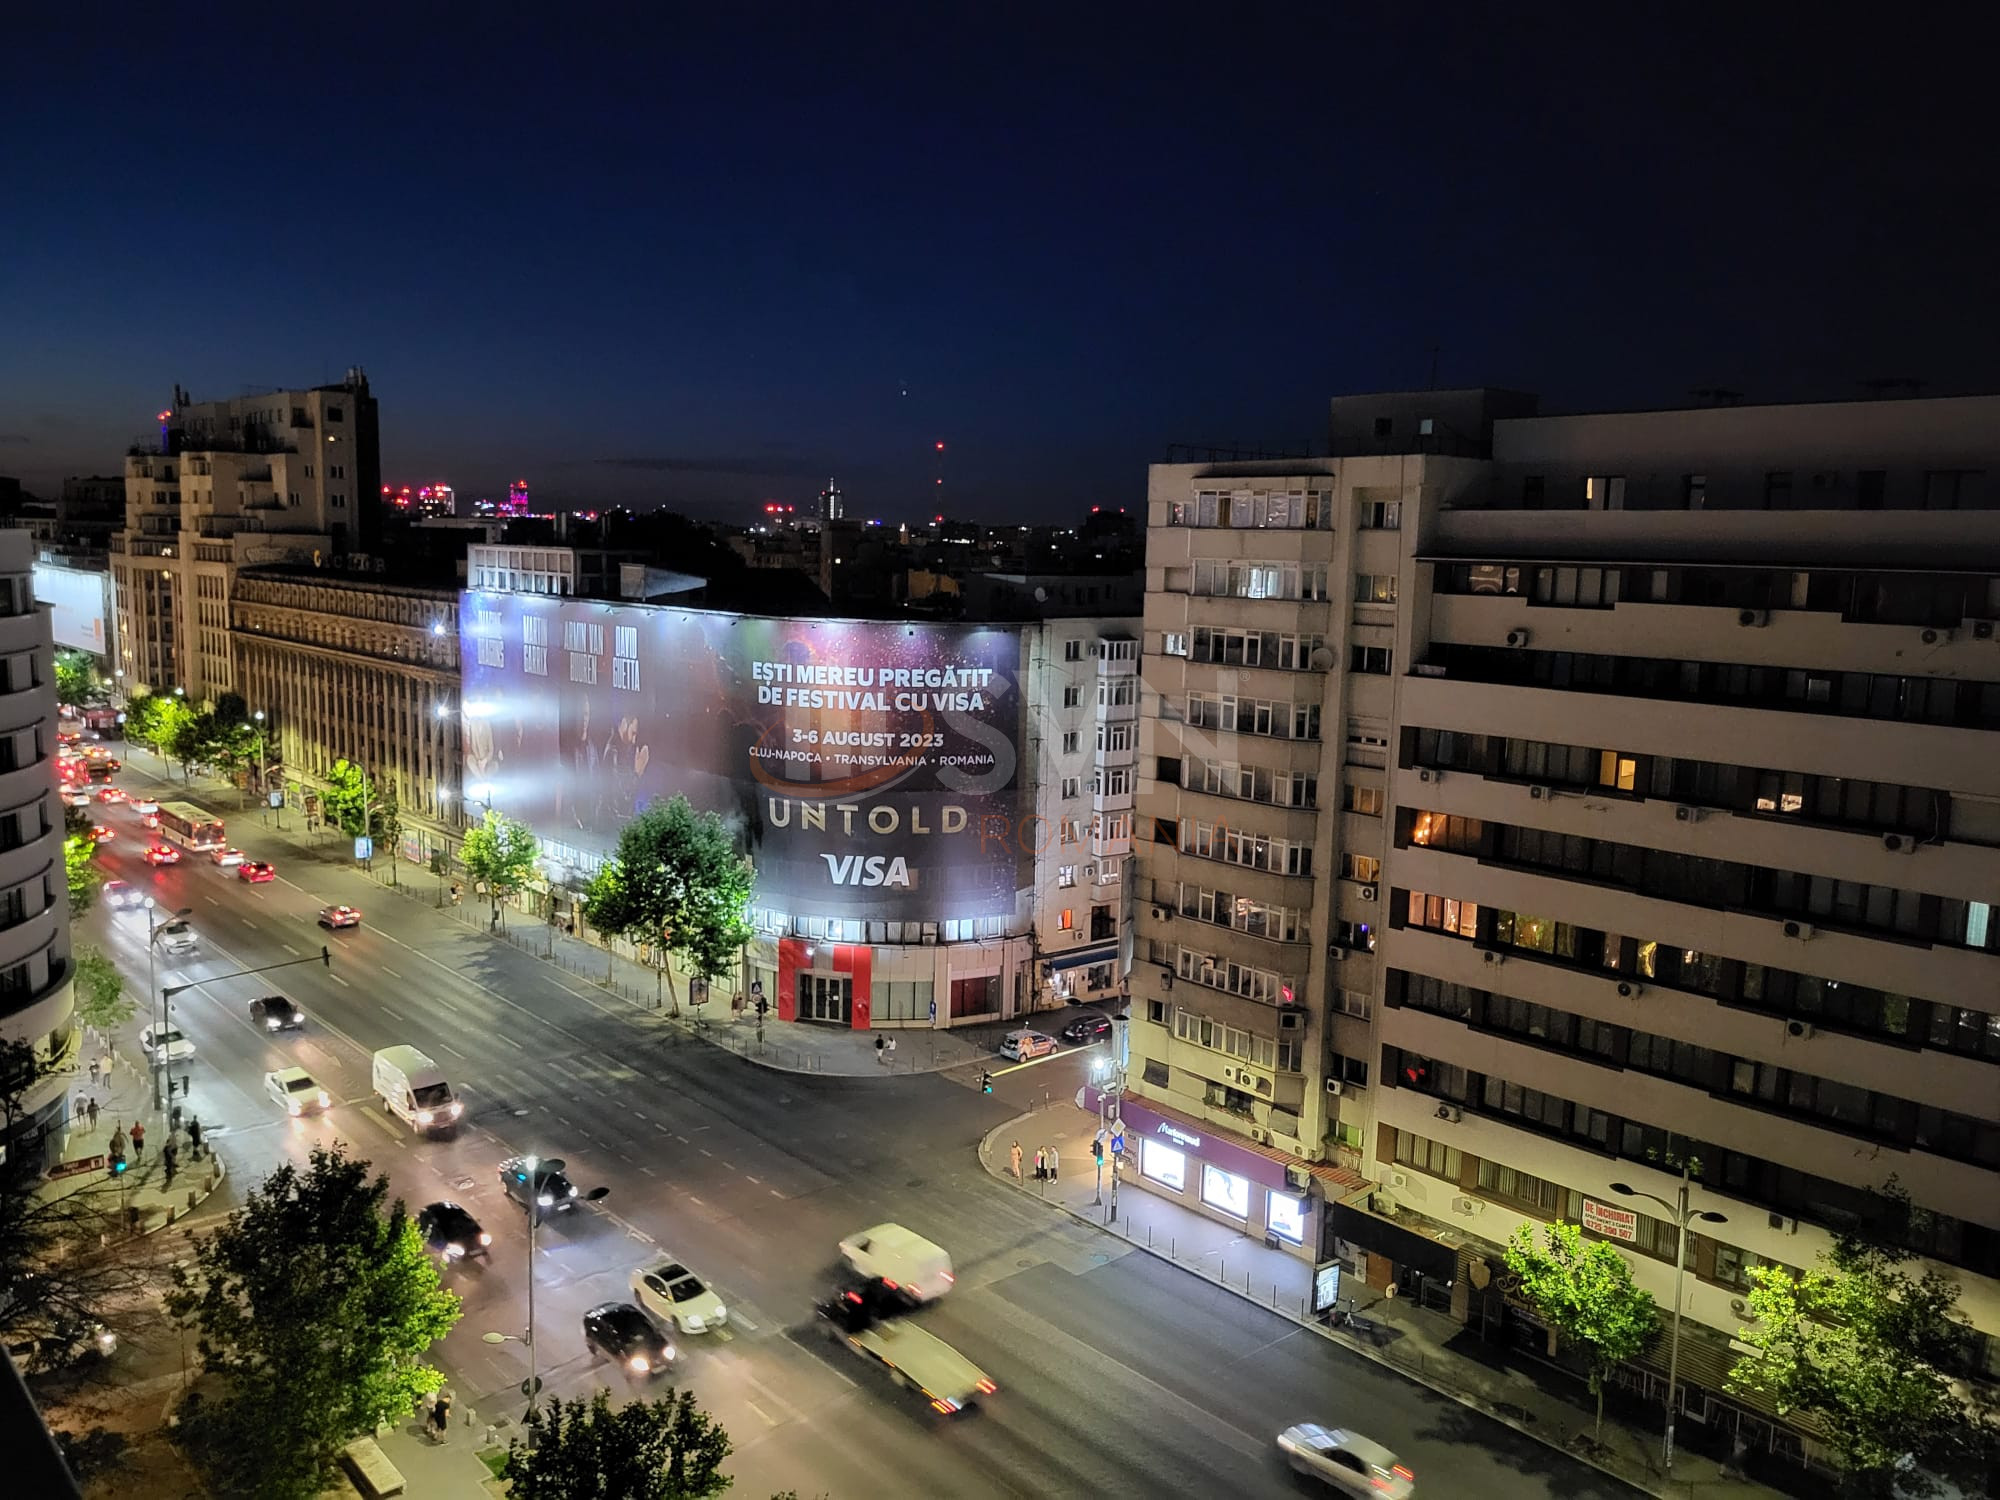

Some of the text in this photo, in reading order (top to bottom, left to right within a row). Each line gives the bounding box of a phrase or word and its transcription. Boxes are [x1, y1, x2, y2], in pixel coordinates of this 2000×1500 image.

[615, 625, 638, 660] DAVID
[612, 656, 641, 692] GUETTA
[796, 664, 874, 687] MEREU
[880, 665, 993, 688] PREGĂTIT
[758, 686, 985, 712] DE FESTIVAL CU VISA
[792, 729, 944, 748] 3-6 AUGUST 2023
[748, 746, 995, 766] CLUJ-NAPOCA TRANSYLVANIA ROMANIA
[768, 797, 968, 837] UNTOLD
[820, 853, 910, 887] VISA
[1585, 1201, 1594, 1213] DE
